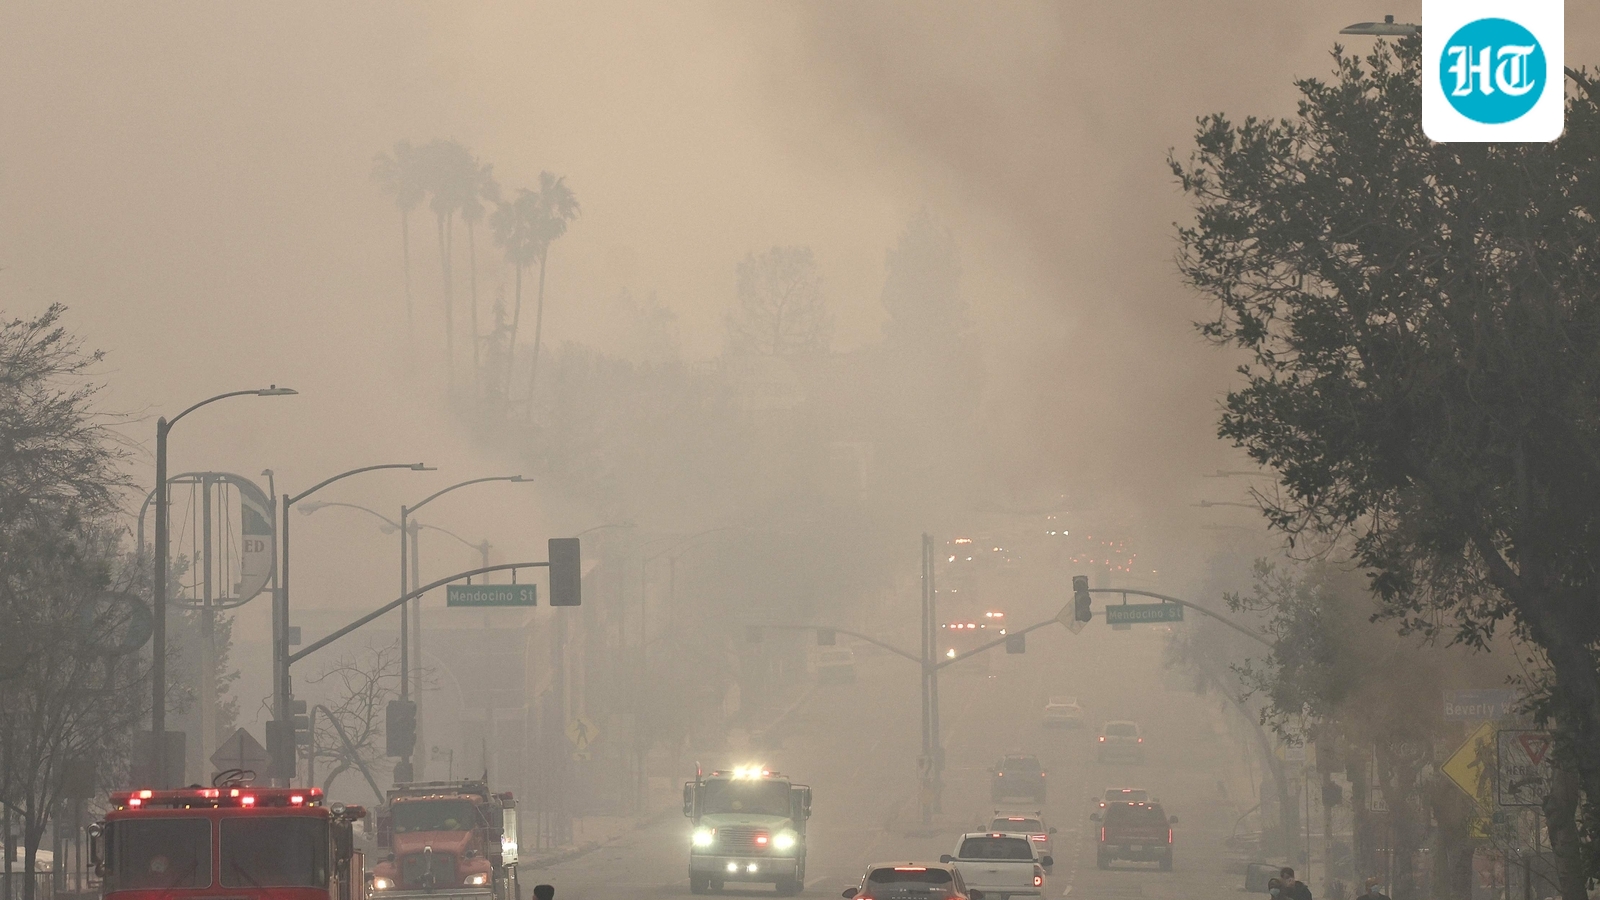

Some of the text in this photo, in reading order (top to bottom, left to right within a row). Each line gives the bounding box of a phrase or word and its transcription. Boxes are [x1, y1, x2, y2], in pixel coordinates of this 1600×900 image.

[449, 589, 534, 601] Mendocino St
[1108, 607, 1181, 620] Mendocino St
[1446, 701, 1495, 718] Beverly
[1506, 765, 1528, 776] HER
